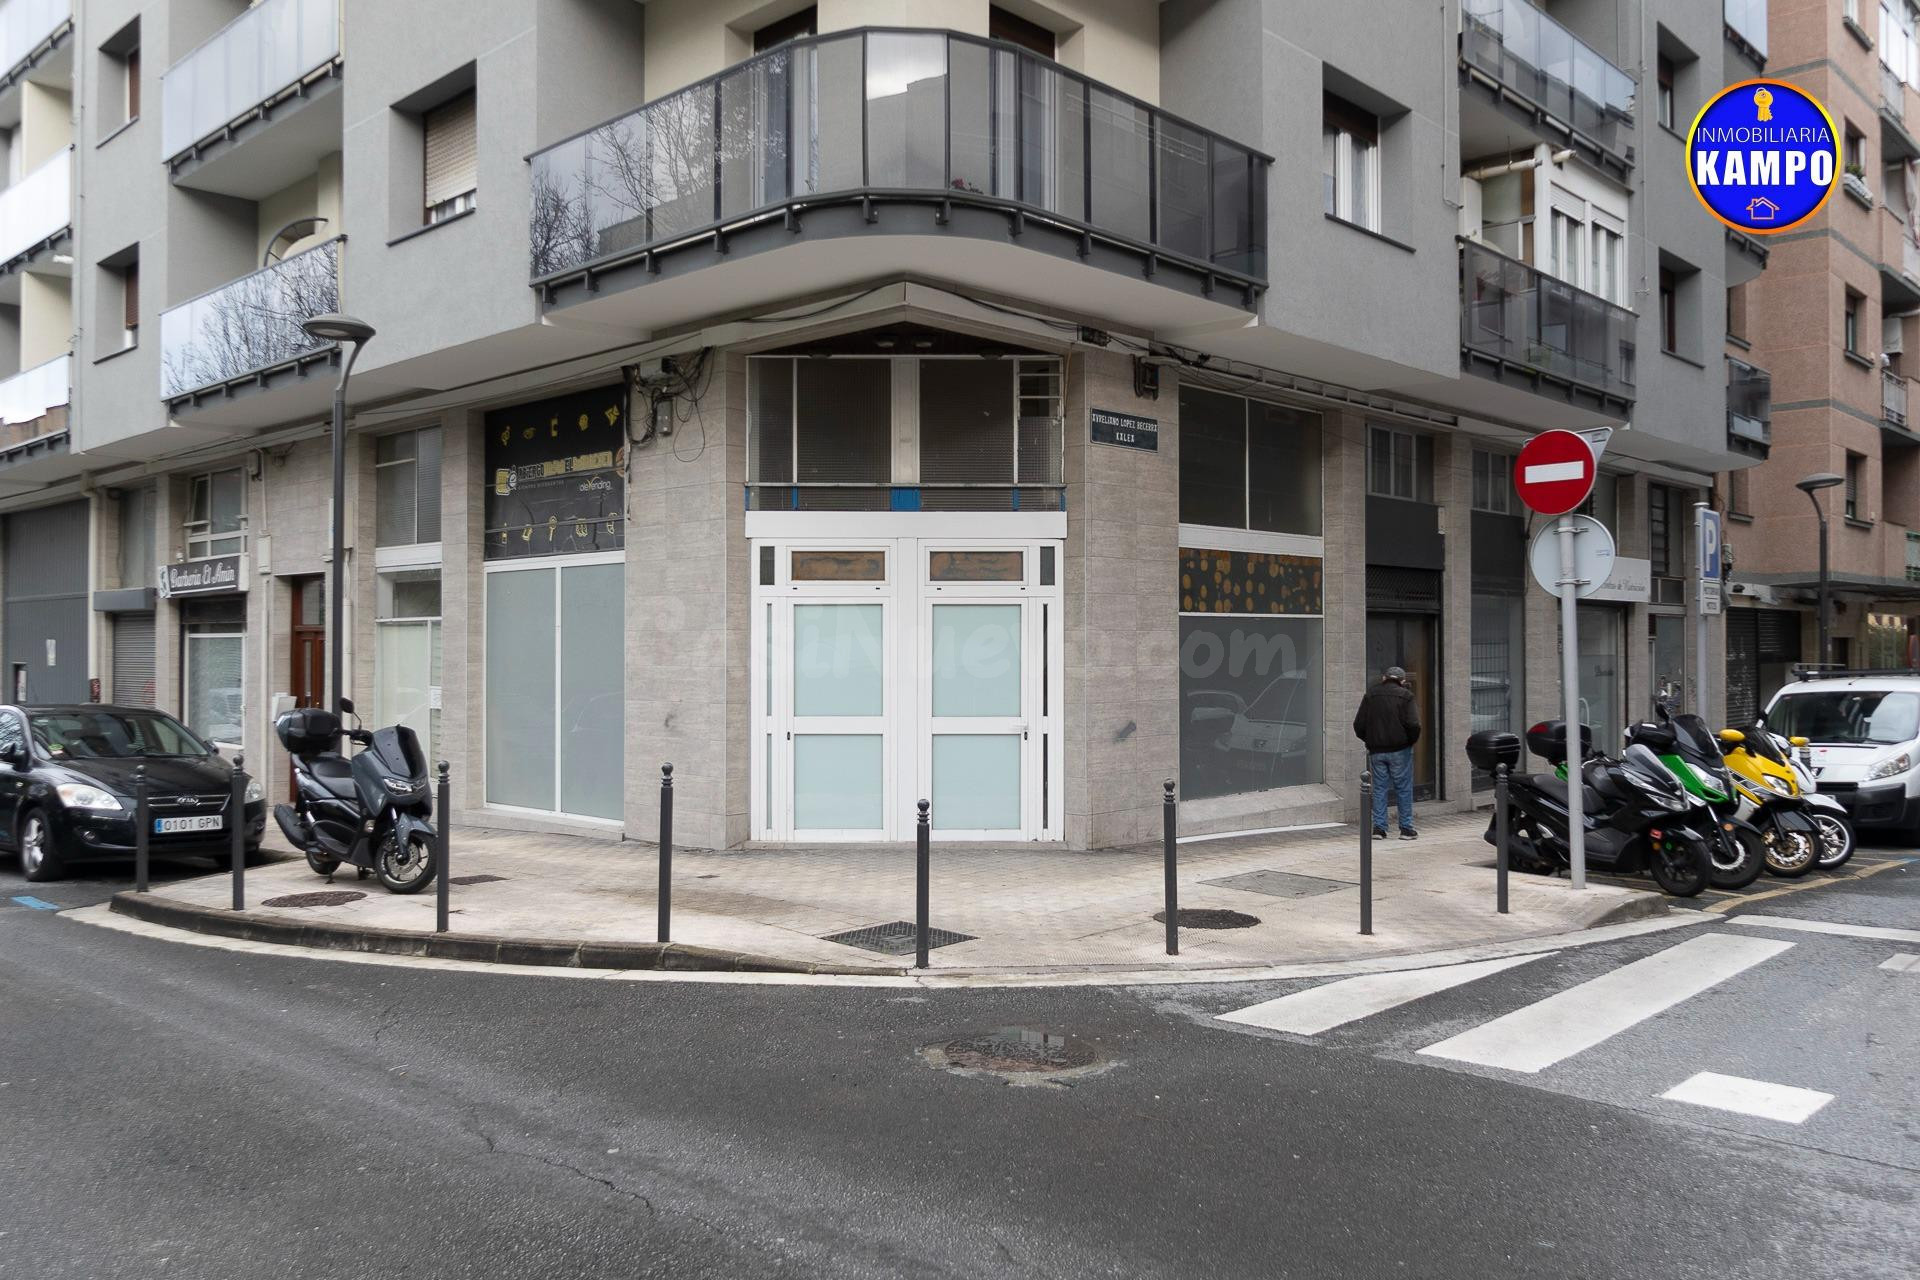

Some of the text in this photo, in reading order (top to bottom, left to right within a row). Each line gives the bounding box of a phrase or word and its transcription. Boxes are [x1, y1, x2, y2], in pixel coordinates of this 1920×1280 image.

[1705, 518, 1717, 572] P
[164, 817, 220, 831] 0101 GPN
